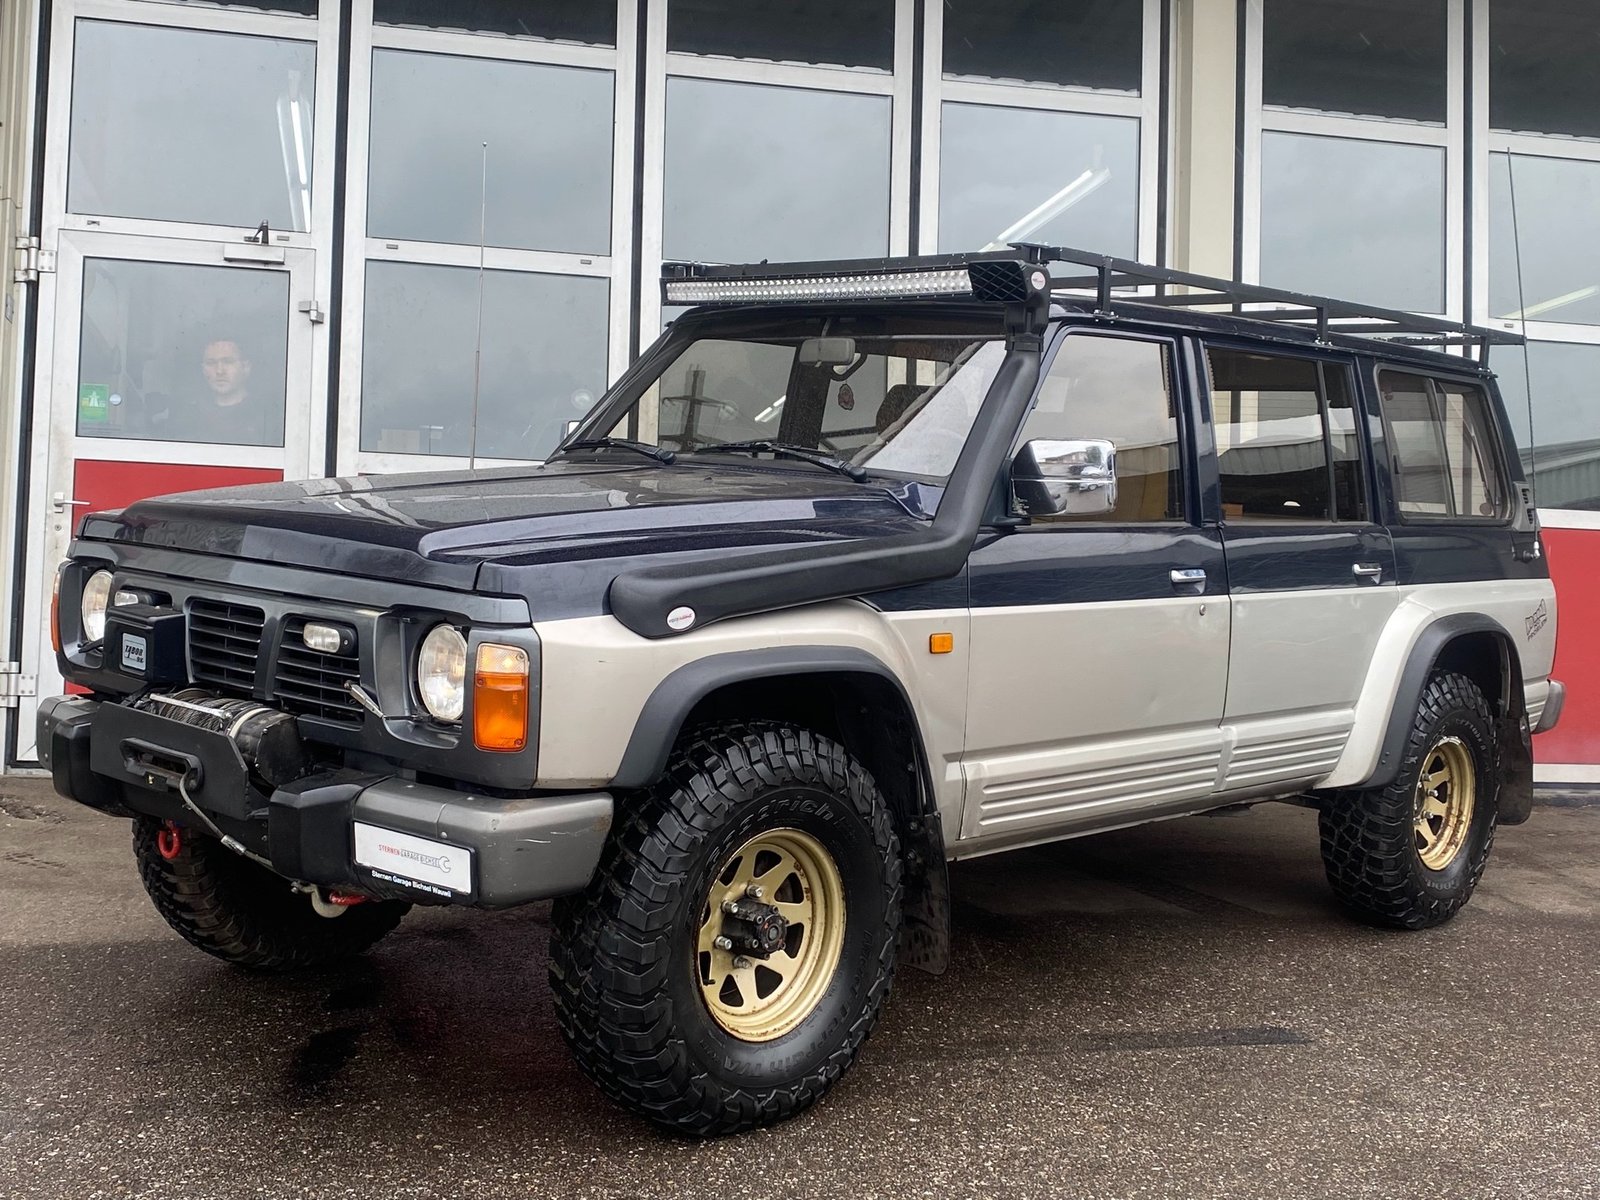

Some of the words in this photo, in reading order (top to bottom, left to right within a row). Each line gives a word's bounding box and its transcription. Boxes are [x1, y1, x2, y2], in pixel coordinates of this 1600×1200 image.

[125, 645, 144, 658] TABOR
[371, 870, 392, 881] Sternen
[392, 876, 412, 887] Garage
[412, 881, 432, 892] Bichsel
